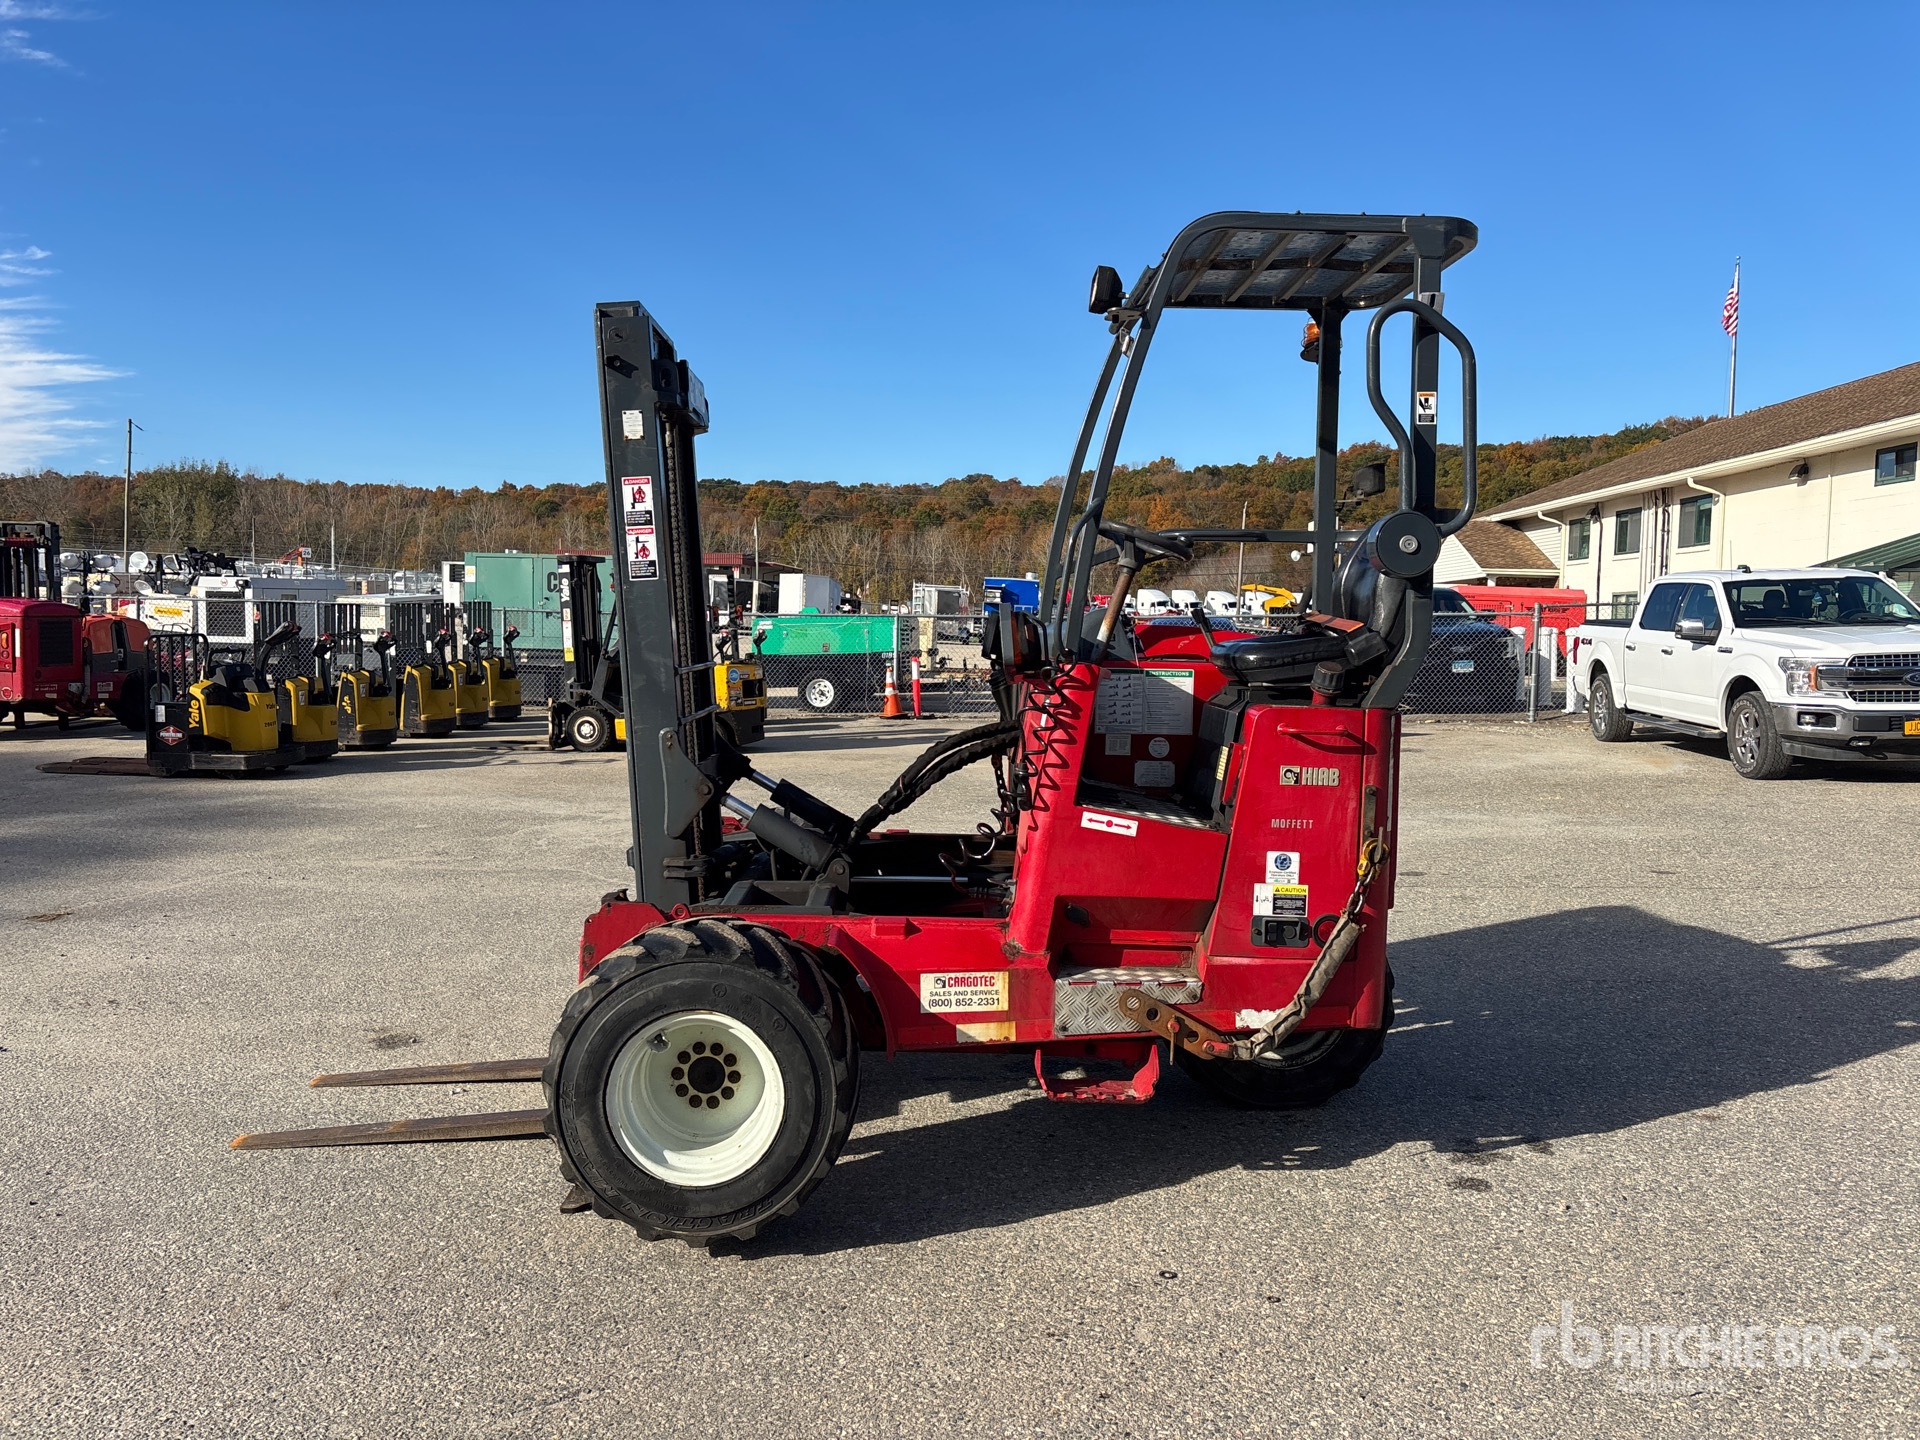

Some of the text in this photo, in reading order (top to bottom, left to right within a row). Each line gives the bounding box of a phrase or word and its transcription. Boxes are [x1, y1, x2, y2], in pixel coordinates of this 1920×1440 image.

[560, 577, 571, 603] Yale
[188, 699, 200, 729] Yale
[1301, 767, 1340, 787] HIAB
[1271, 818, 1314, 829] MOFFETT
[947, 975, 996, 988] CARGOTEC
[928, 997, 1000, 1009] (800) 852-2331
[624, 1197, 774, 1230] TRACTION
